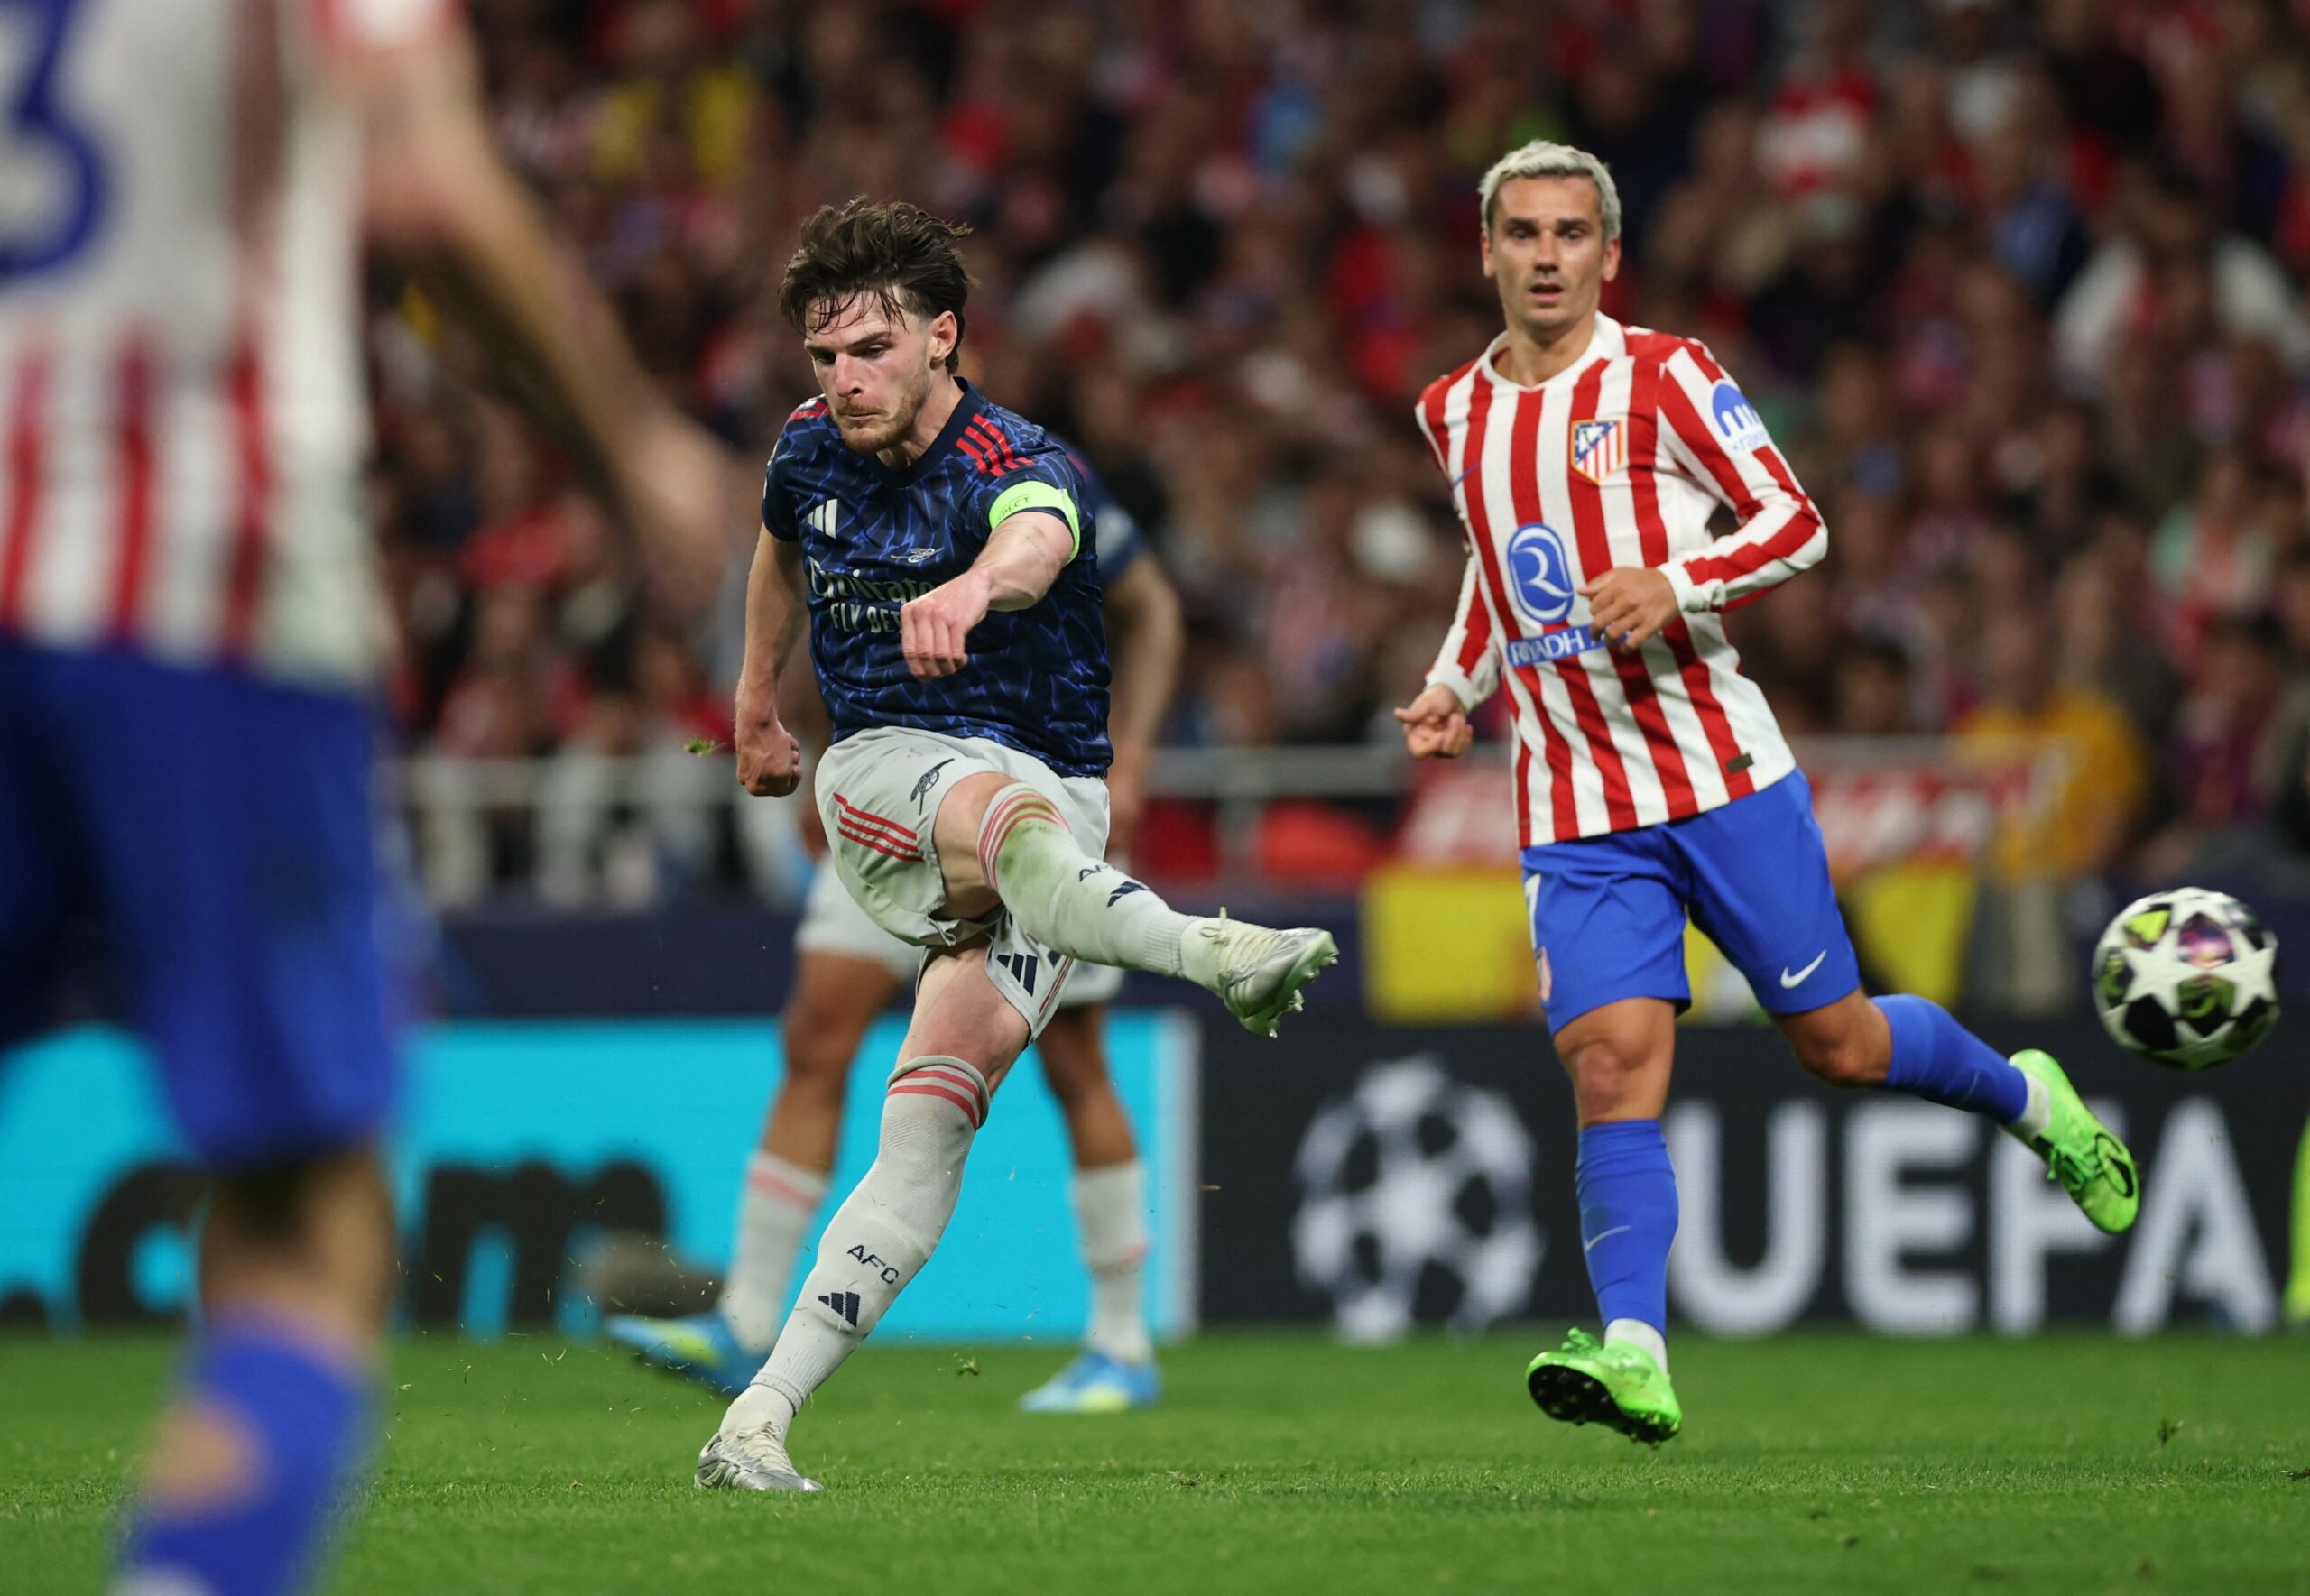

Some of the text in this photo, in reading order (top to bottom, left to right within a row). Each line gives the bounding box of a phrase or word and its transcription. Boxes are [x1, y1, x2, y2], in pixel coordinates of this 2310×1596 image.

[808, 555, 935, 604] Emirate
[830, 602, 902, 633] FLY BET
[1664, 1094, 2280, 1338] UEFA
[846, 1244, 899, 1284] AFC
